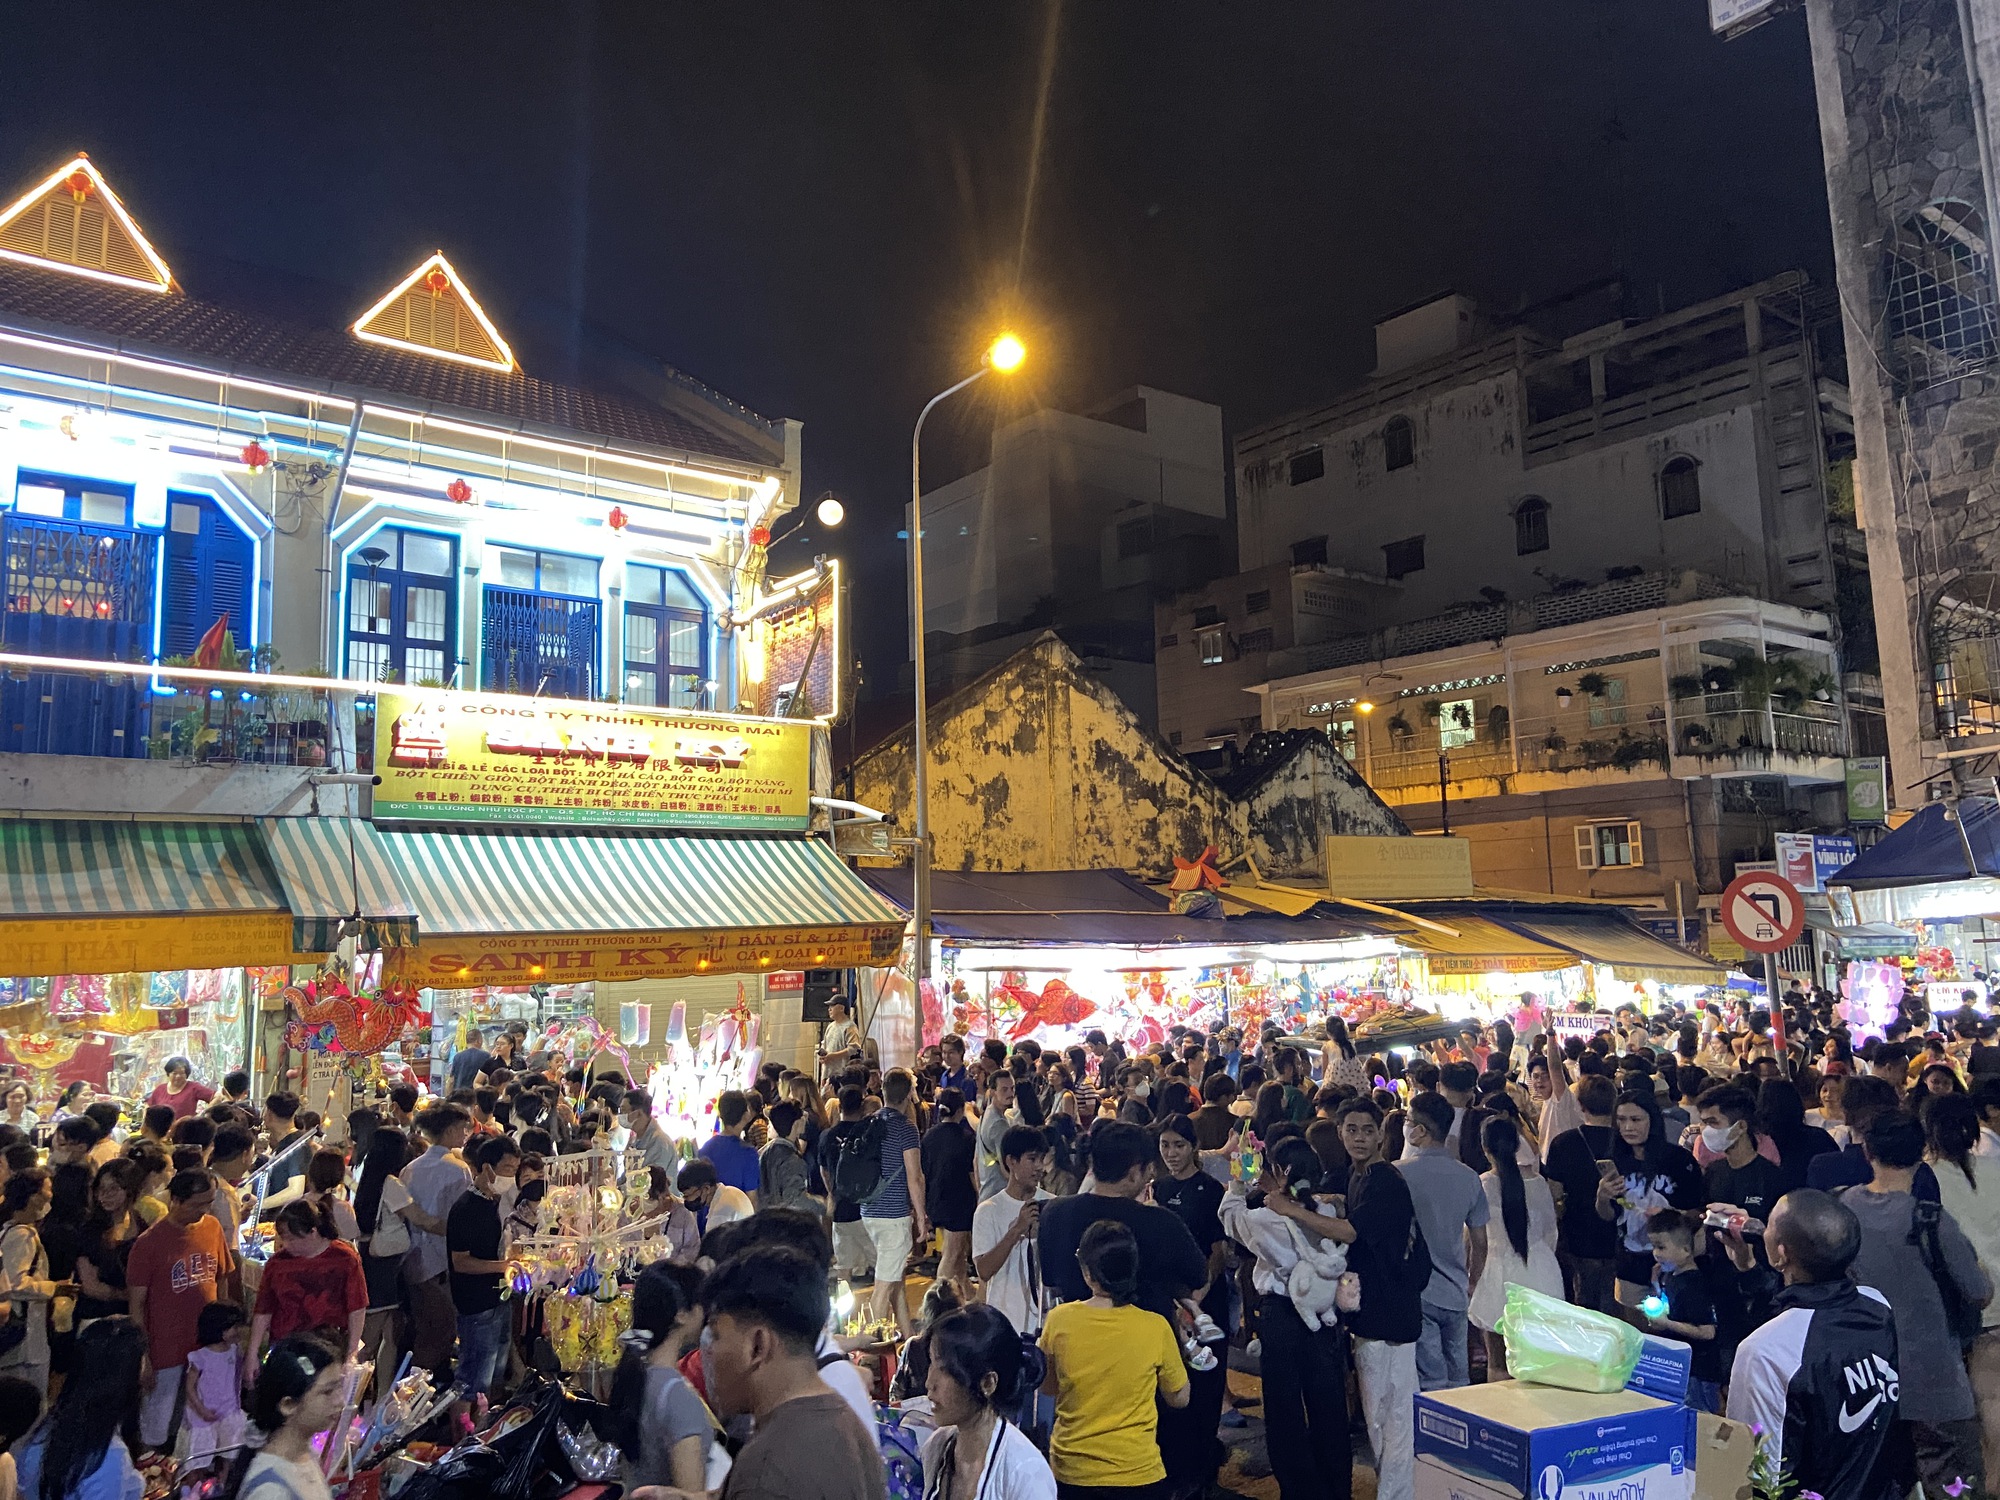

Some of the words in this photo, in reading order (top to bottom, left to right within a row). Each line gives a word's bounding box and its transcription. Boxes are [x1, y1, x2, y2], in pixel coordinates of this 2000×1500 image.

[462, 704, 535, 718] CÔNG
[545, 711, 573, 720] TY
[581, 714, 644, 725] TNHH
[650, 719, 740, 733] THƯƠNG
[746, 726, 781, 738] MẠI
[458, 763, 468, 771] &
[493, 765, 518, 773] CÁC
[522, 767, 549, 776] LOẠI
[587, 770, 615, 779] BỘT
[670, 774, 696, 783] BỘT
[394, 769, 428, 779] BỘT
[432, 771, 480, 781] CHIÊN
[528, 776, 558, 785] BỘT
[560, 777, 598, 787] BÁNH
[633, 781, 660, 790] BỘT
[662, 782, 697, 791] BÁNH
[716, 785, 742, 794] BỘT
[743, 786, 776, 795] BÁNH
[479, 938, 517, 949] CÔNG
[521, 939, 539, 948] TY
[543, 938, 580, 947] TNHH
[584, 935, 635, 946] THƯƠNG
[639, 935, 664, 945] MẠI
[737, 934, 777, 947] BÁN
[807, 933, 820, 943] &
[429, 950, 596, 973] SANH
[616, 942, 694, 966] KÝ
[775, 946, 811, 959] LOẠI
[1568, 1014, 1594, 1029] KHÓI
[1651, 1356, 1683, 1368] AQUAFINA
